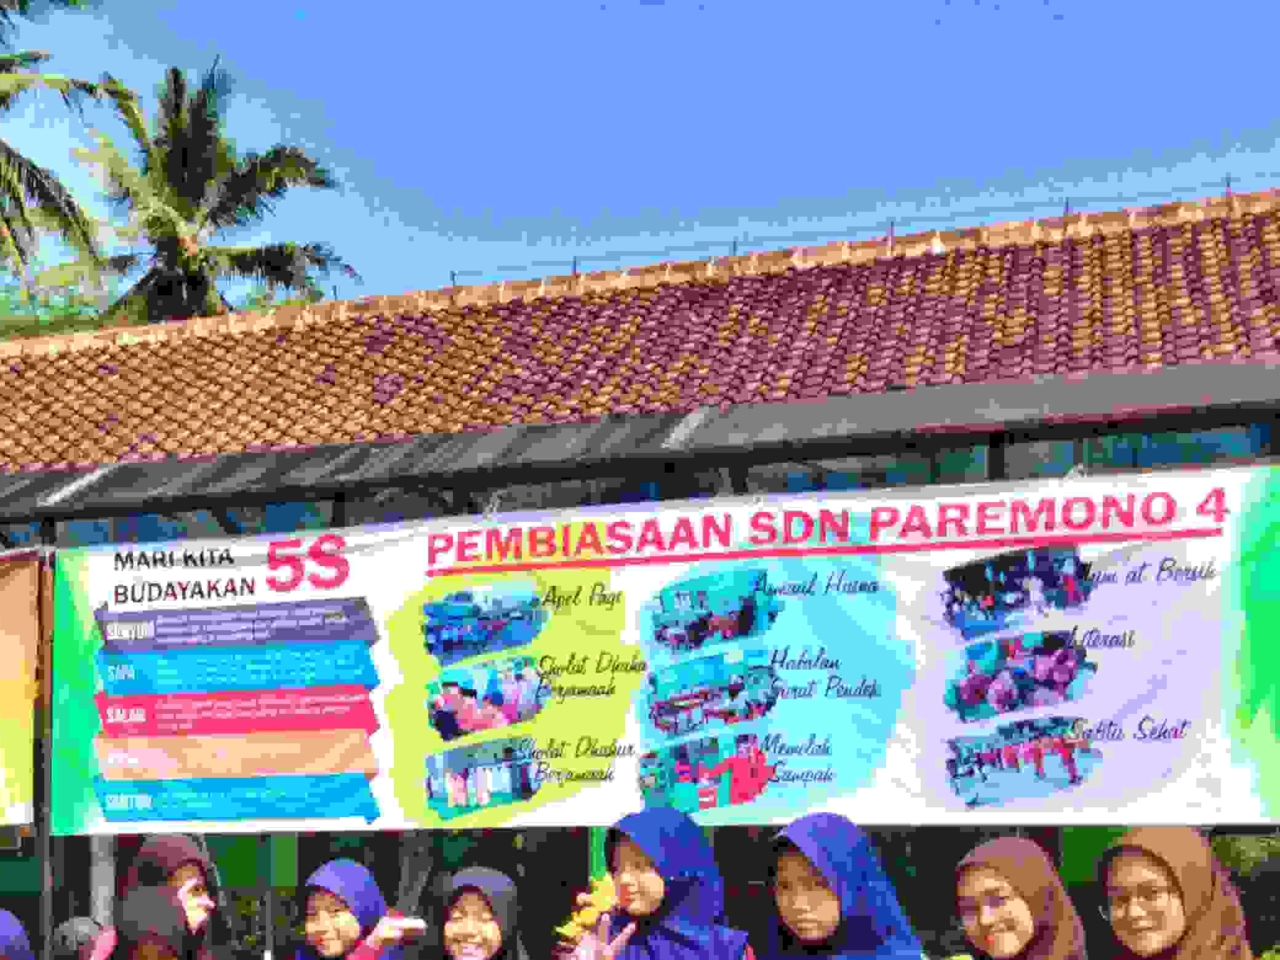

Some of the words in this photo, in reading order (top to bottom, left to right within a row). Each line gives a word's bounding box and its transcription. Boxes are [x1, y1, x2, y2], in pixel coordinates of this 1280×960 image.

[427, 513, 732, 565] PEMBIASAAN
[749, 508, 851, 546] SDN
[869, 491, 1178, 542] PAREMONO
[1195, 487, 1230, 523] 4
[113, 550, 175, 571] MARI
[182, 547, 235, 568] KITA
[265, 533, 350, 592] 5S
[113, 577, 256, 604] BUDAYAKAN
